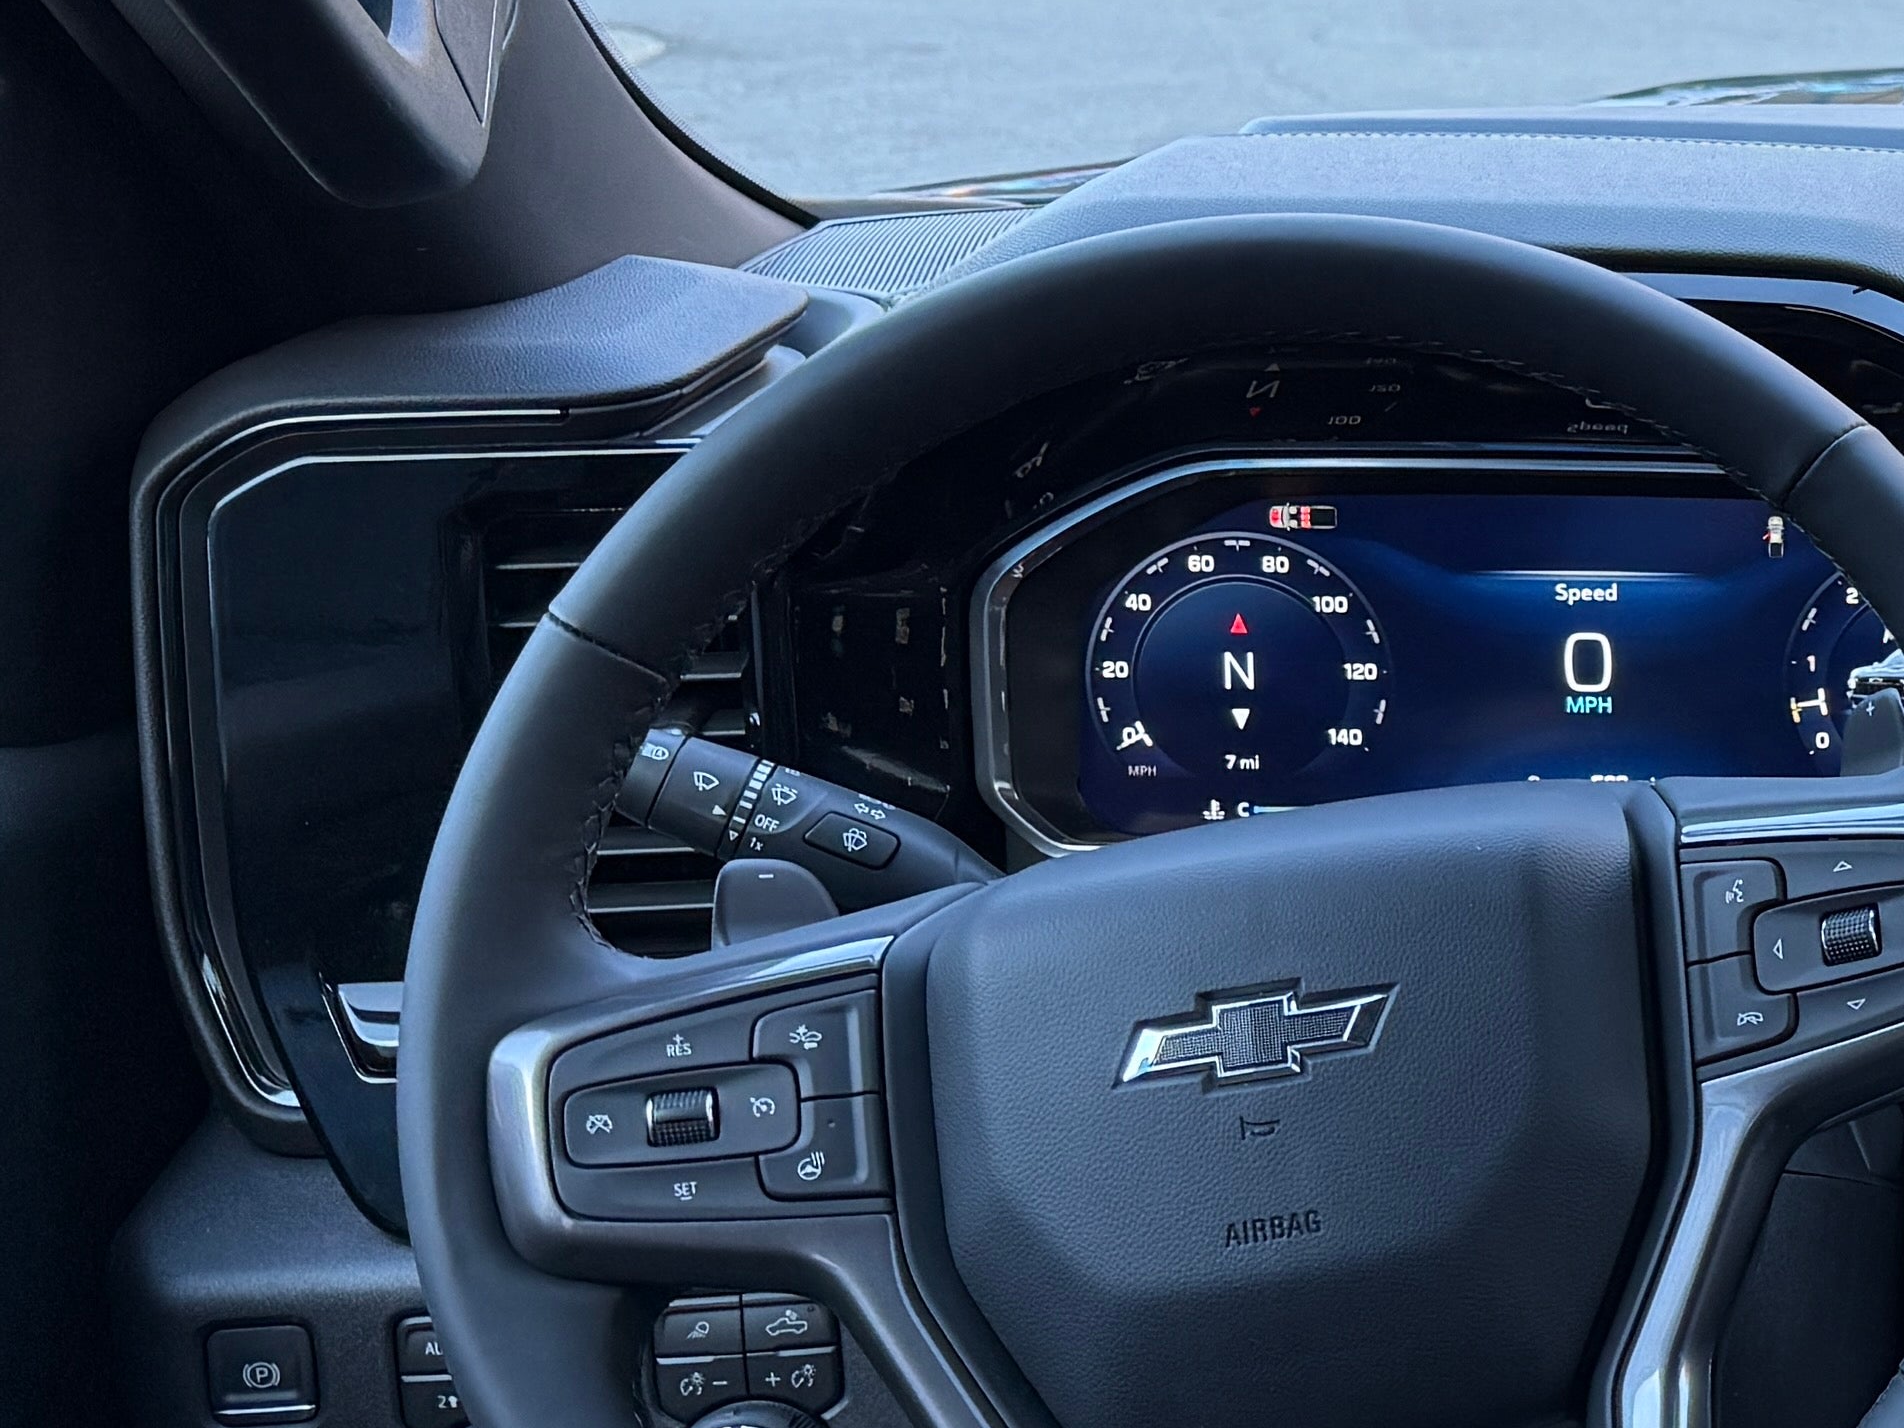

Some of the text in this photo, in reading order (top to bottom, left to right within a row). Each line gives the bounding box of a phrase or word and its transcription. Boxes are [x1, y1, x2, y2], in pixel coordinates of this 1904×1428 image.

[1187, 555, 1215, 573] 60
[1261, 555, 1290, 573] 80
[1125, 594, 1151, 611] 40
[1554, 583, 1618, 605] Speed
[1845, 587, 1859, 604] 2
[1312, 595, 1348, 613] 100
[1102, 661, 1128, 678] 20
[1223, 651, 1255, 690] N
[1343, 662, 1377, 681] 120
[1564, 632, 1613, 693] 0
[1807, 655, 1816, 672] 1
[1566, 696, 1613, 714] MPH
[1122, 726, 1136, 744] 0
[1327, 727, 1363, 746] 140
[1815, 731, 1830, 750] 0
[1128, 765, 1156, 776] MPH
[1224, 754, 1260, 770] 7 mi
[1237, 802, 1250, 818] C
[753, 814, 779, 832] OFF
[750, 836, 764, 852] 1x
[666, 1043, 692, 1057] RES
[674, 1182, 697, 1197] SET
[1225, 1209, 1322, 1248] AIRBAG
[425, 1341, 443, 1355] AU
